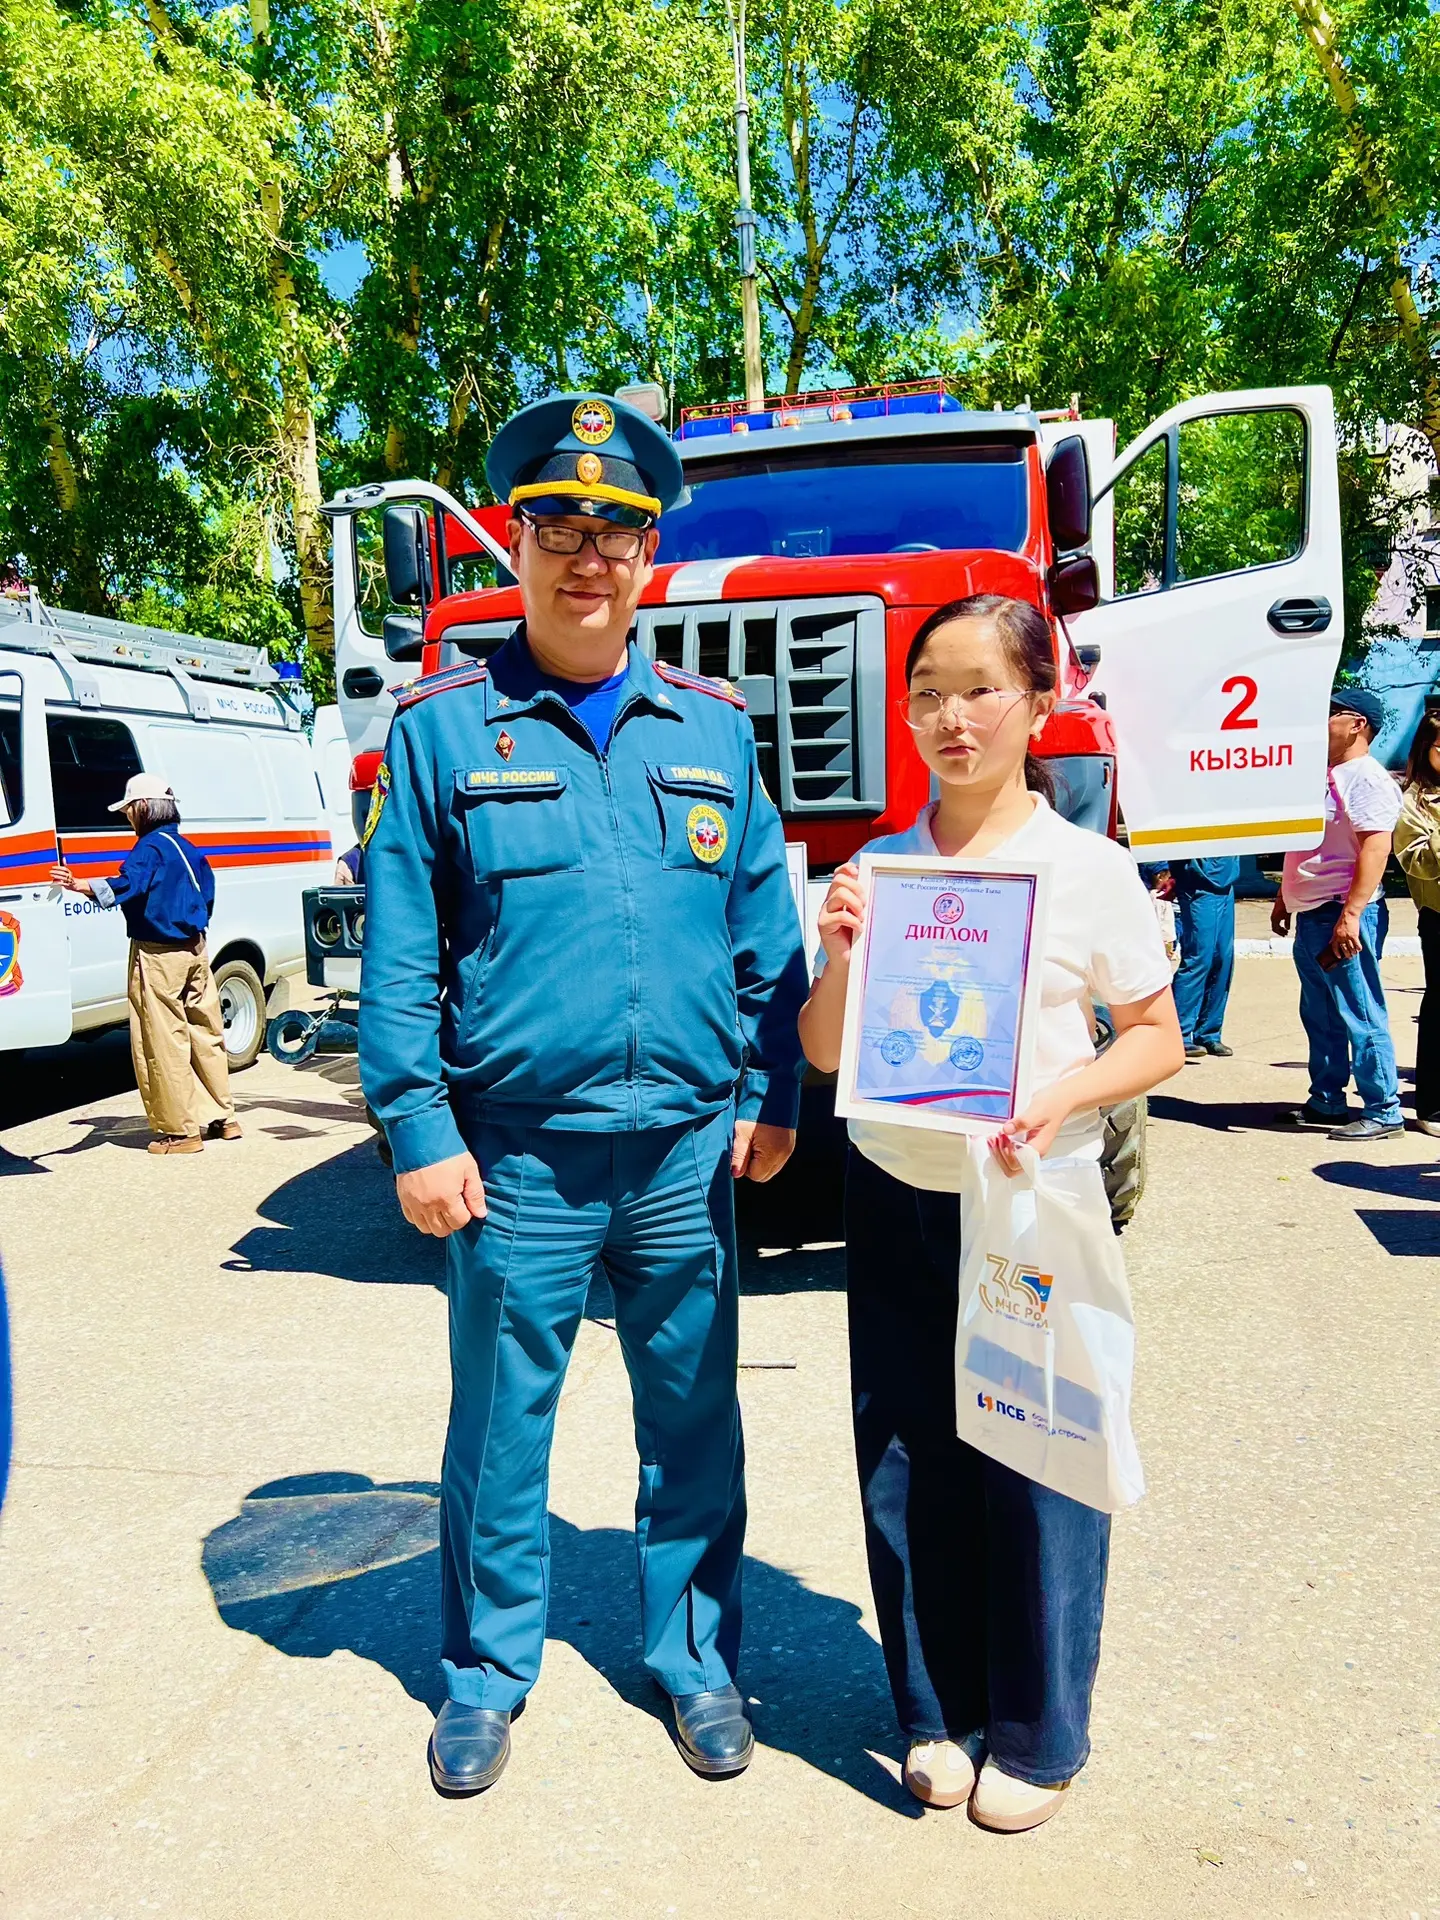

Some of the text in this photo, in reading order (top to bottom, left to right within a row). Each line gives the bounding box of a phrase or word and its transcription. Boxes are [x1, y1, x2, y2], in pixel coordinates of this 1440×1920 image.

[216, 698, 238, 711] МЧС
[1220, 675, 1258, 731] 2
[1190, 744, 1293, 772] КЫЗЫЛ
[470, 770, 556, 785] МЧС РОССИИ
[904, 924, 989, 943] ДИПЛОМ
[979, 1253, 1041, 1313] 35
[995, 1296, 1021, 1315] МЧС
[996, 1400, 1026, 1421] ПСБ
